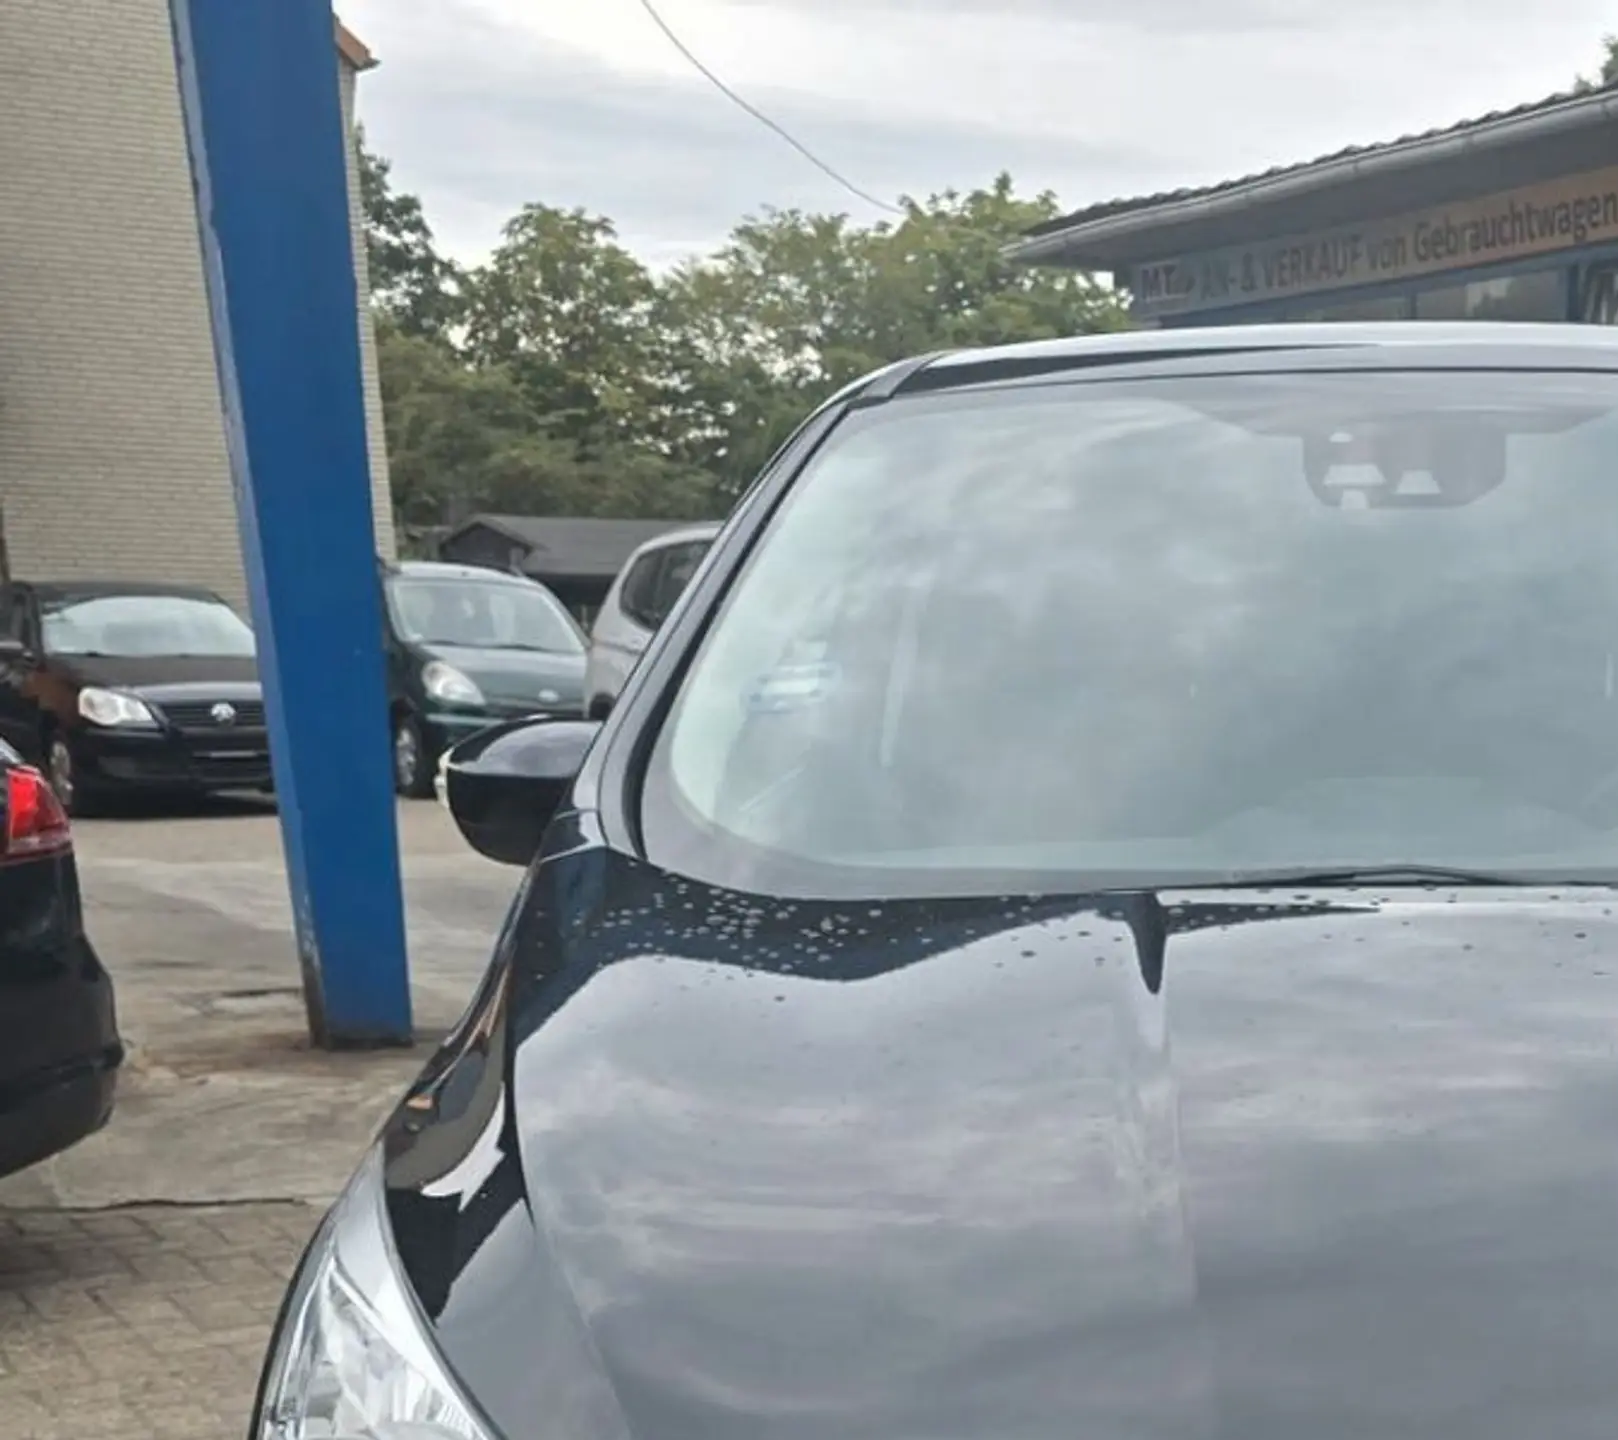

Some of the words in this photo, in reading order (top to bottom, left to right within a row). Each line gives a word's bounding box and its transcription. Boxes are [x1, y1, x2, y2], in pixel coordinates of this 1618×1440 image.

[1263, 234, 1362, 289] VERKAUF
[1370, 235, 1406, 271] von
[1415, 190, 1618, 262] Gebrauchtwagen
